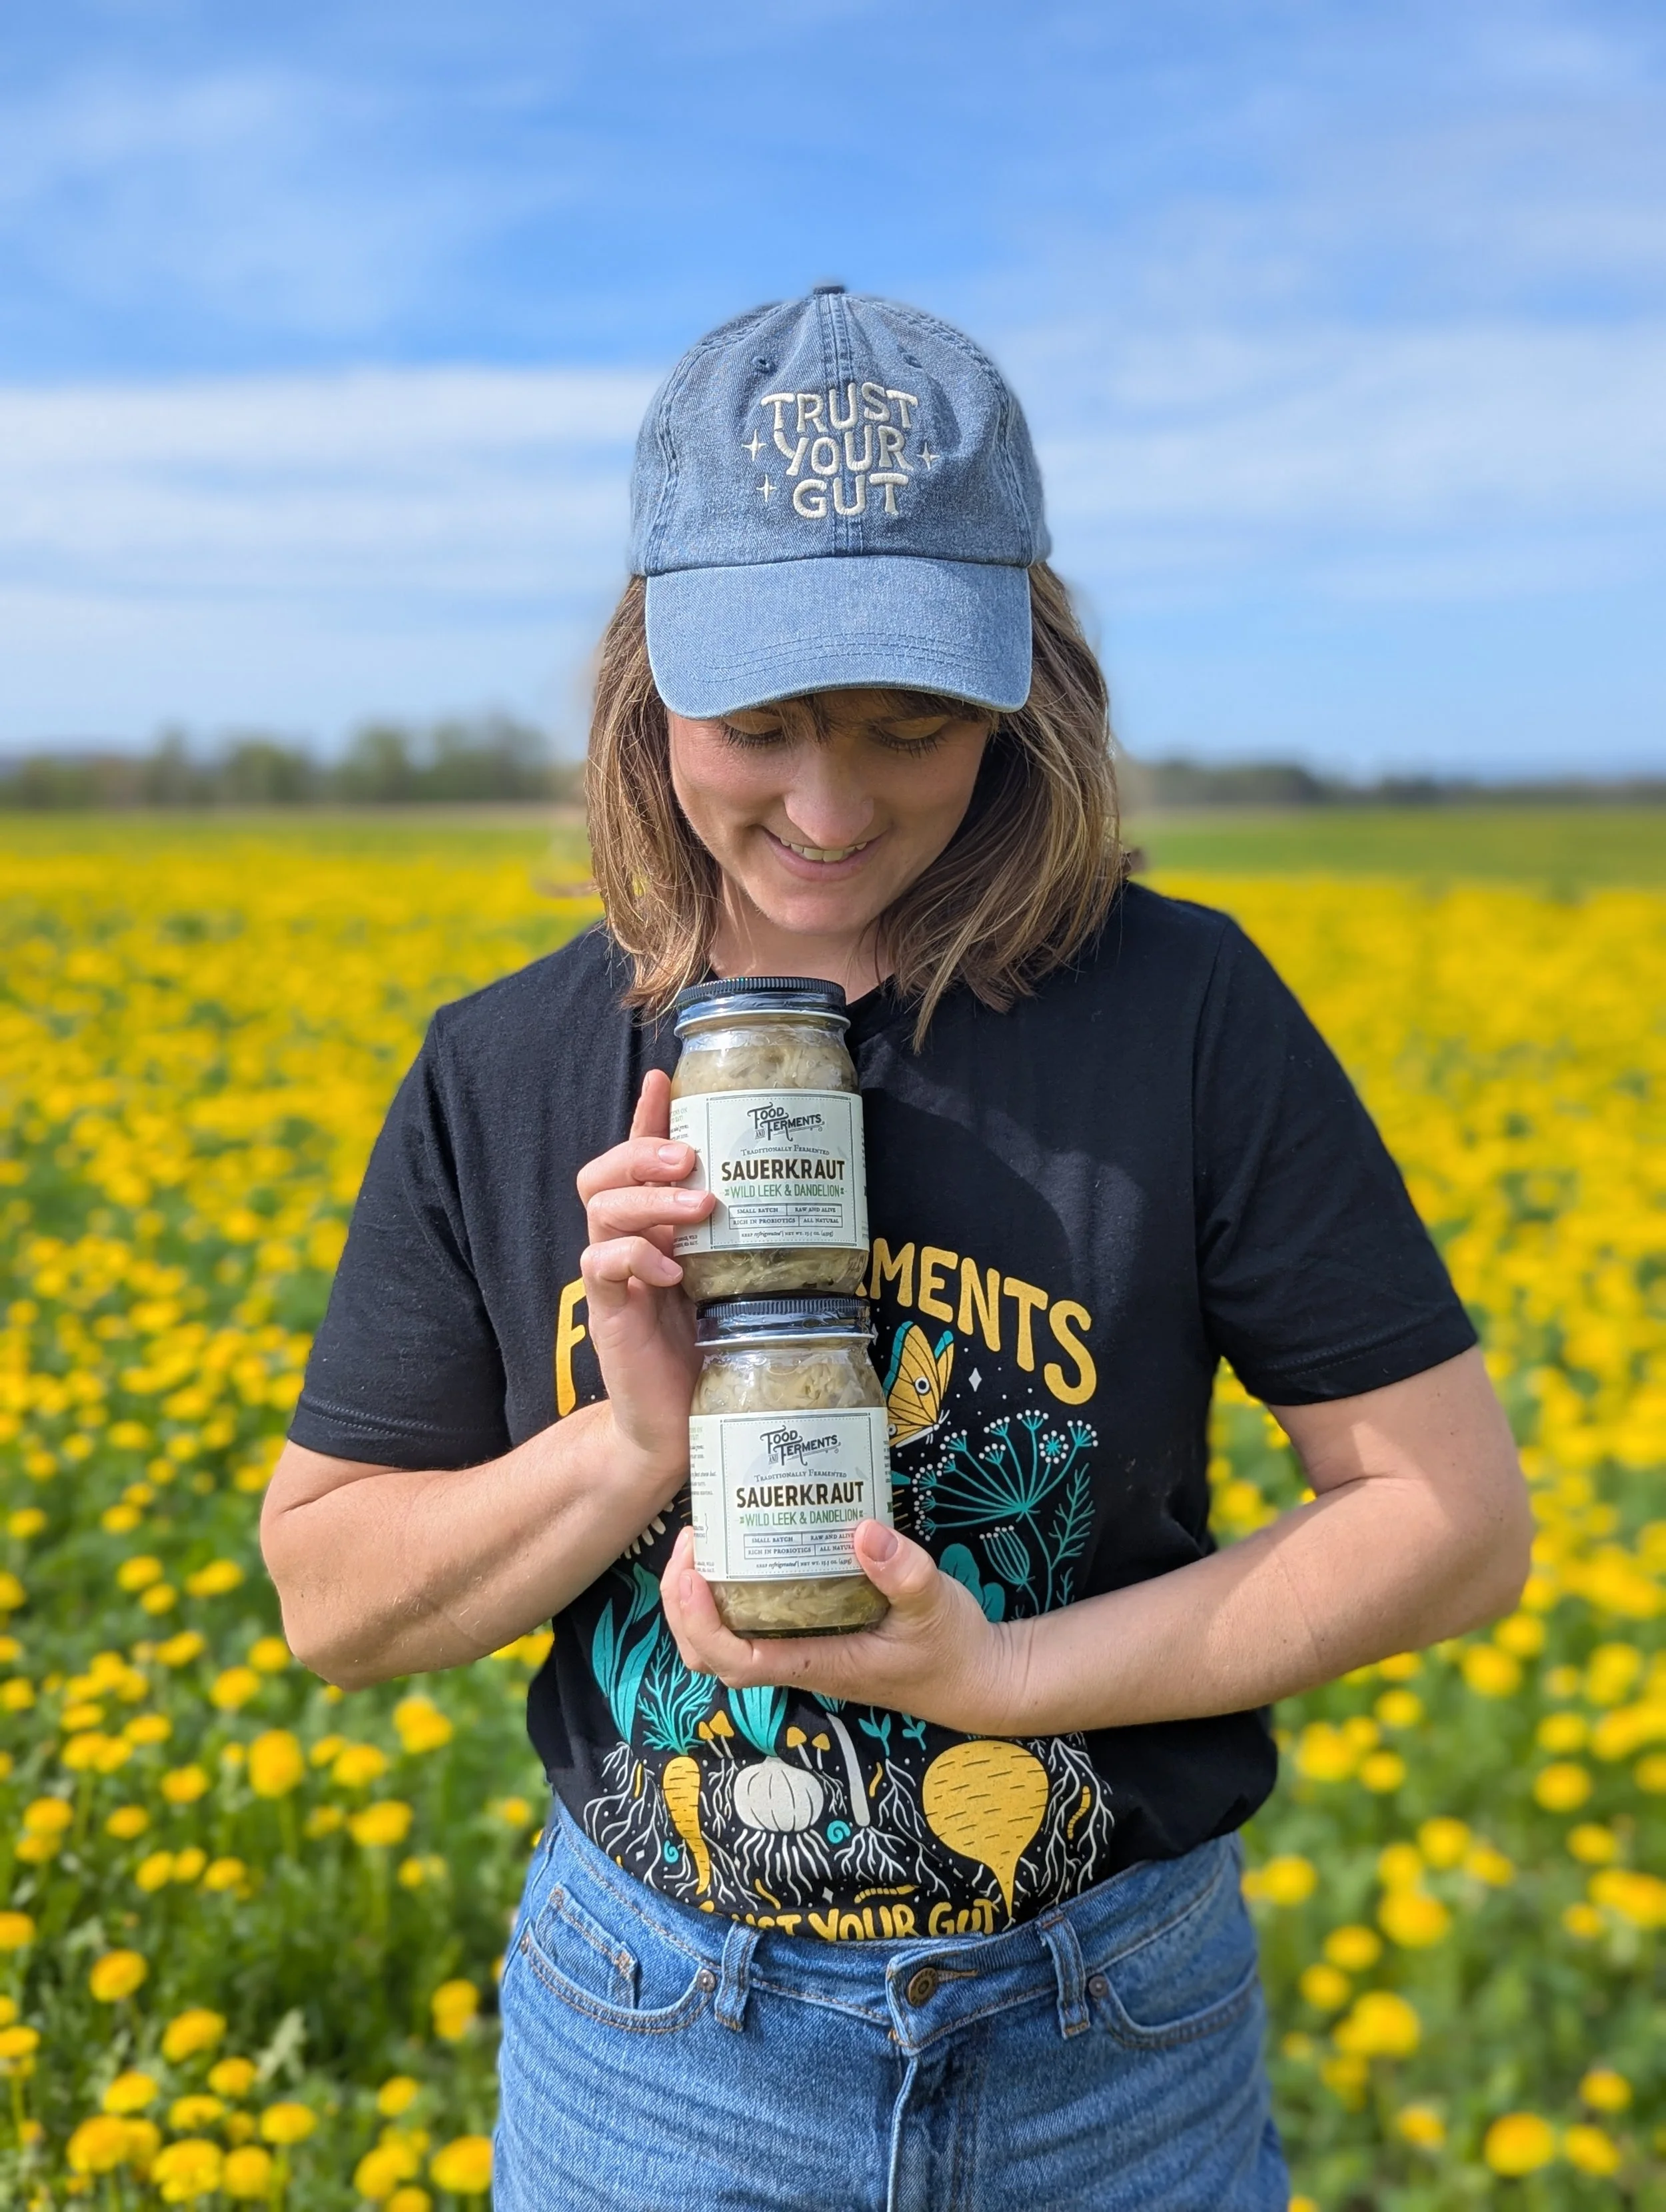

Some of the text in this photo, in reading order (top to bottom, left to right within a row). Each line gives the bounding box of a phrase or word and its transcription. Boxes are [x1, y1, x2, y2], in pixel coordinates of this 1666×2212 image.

[761, 382, 918, 434] TRUST
[773, 425, 914, 476] YOUR
[793, 472, 909, 519] GUT
[747, 1101, 785, 1129] FOOD
[760, 1113, 824, 1141] FERMENTS
[755, 1129, 766, 1139] AND
[740, 1144, 830, 1157] TRADITIONALLY FERMENTED
[722, 1159, 845, 1181] SAUERKRAUT
[730, 1183, 840, 1198] WILD LEEK & DANDELION
[855, 1237, 1097, 1405] MENTS
[760, 1424, 798, 1454] FOOD
[773, 1434, 838, 1466] FERMENTS
[768, 1453, 778, 1464] AND
[754, 1468, 847, 1482] TRADITIONALLY FERMENTED
[736, 1481, 864, 1508] SAUERKRAUT
[745, 1508, 858, 1526] WILD LEEK & DANDELION
[808, 1904, 922, 1941] YOUR
[928, 1899, 994, 1937] GUT
